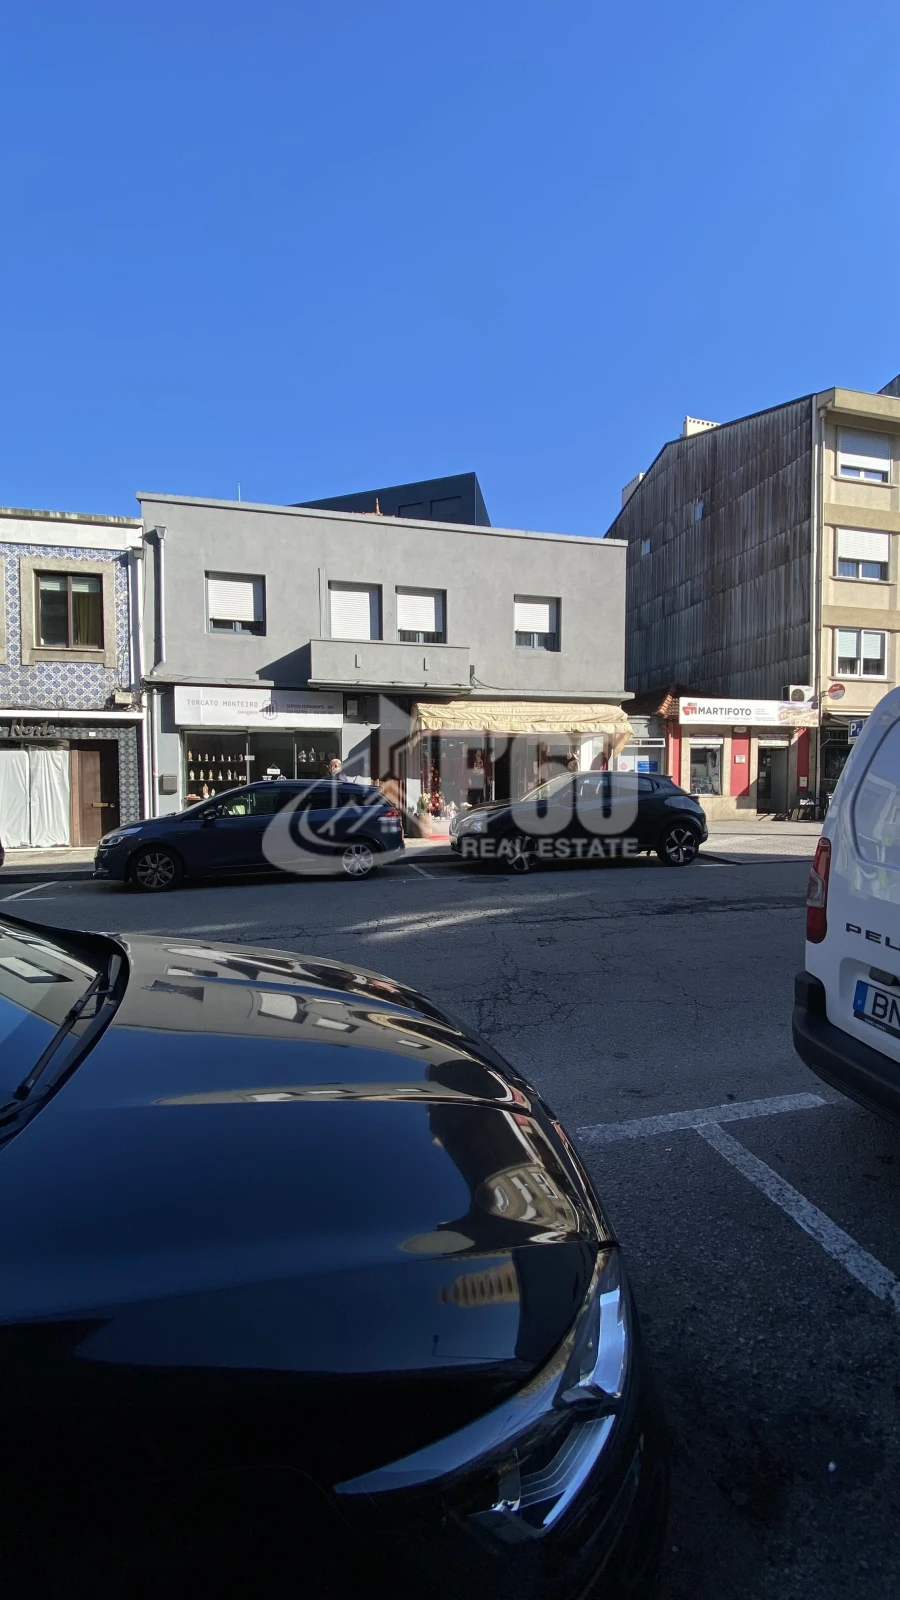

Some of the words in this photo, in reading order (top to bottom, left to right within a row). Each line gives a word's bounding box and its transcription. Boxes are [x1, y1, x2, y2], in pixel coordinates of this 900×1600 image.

[187, 699, 219, 707] TORCATO
[222, 700, 259, 708] MONTEIRO
[697, 705, 752, 717] MARTIFOTO
[850, 723, 857, 736] P
